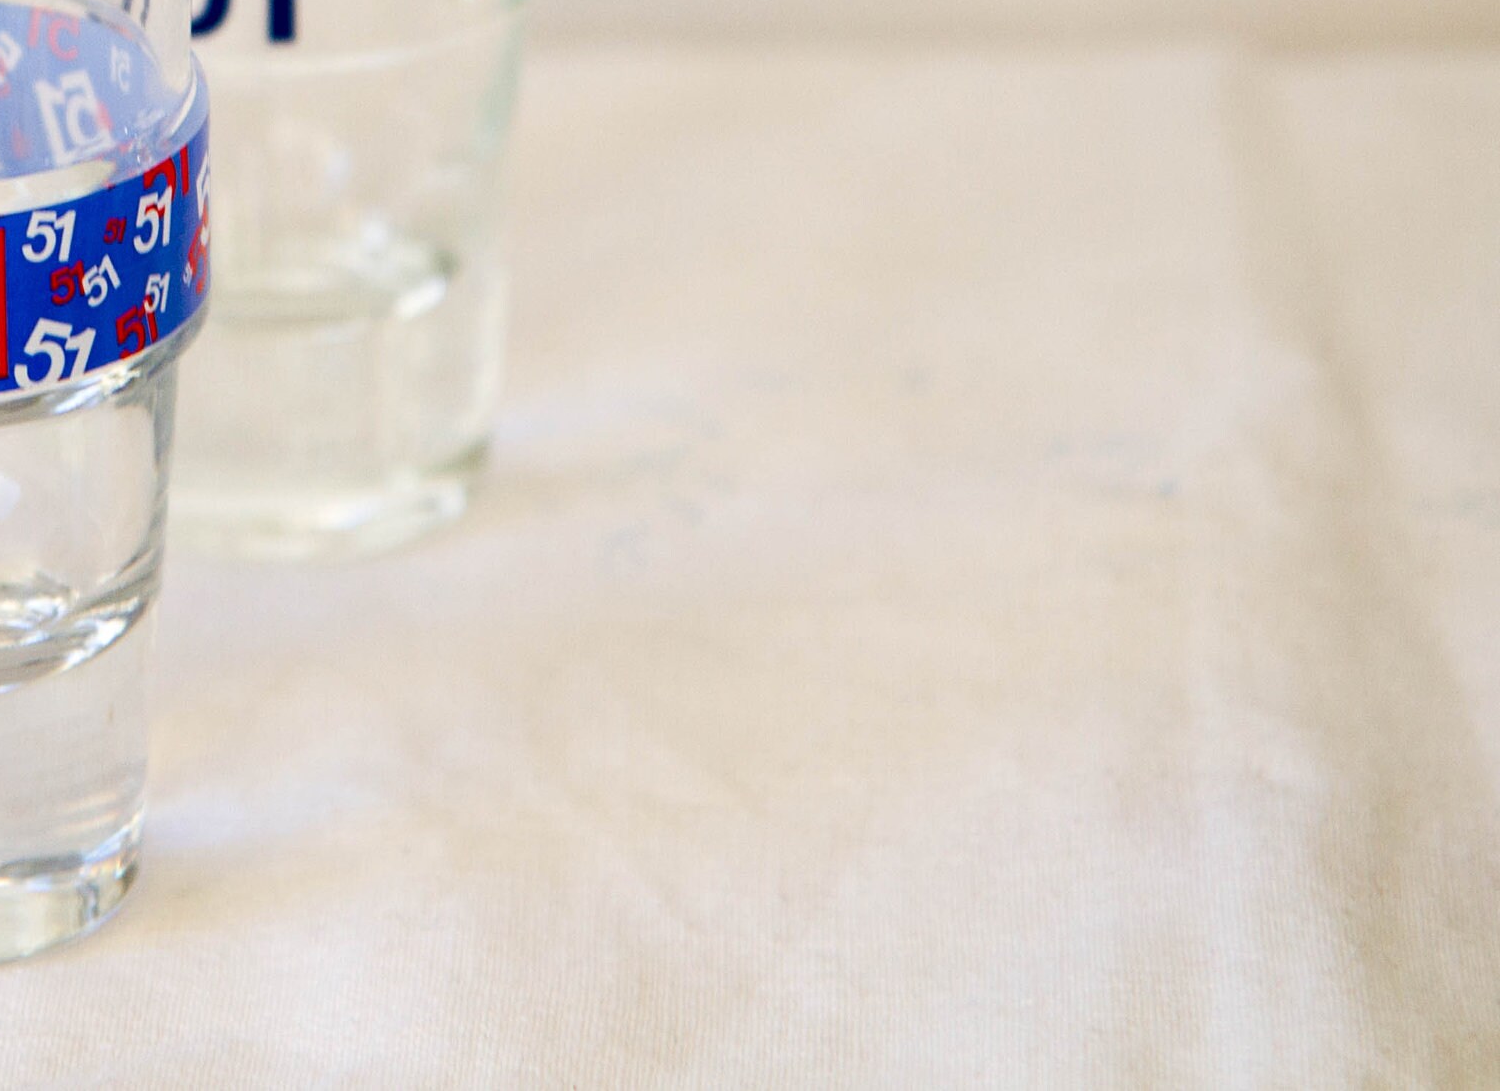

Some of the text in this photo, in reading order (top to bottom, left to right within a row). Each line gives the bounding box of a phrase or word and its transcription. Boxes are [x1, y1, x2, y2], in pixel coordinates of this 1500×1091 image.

[21, 209, 77, 263] 51
[103, 217, 127, 245] 51
[133, 184, 173, 254] 51
[50, 259, 87, 306] 51
[82, 254, 121, 308] 51
[143, 271, 171, 314] 51
[13, 317, 97, 390] 51
